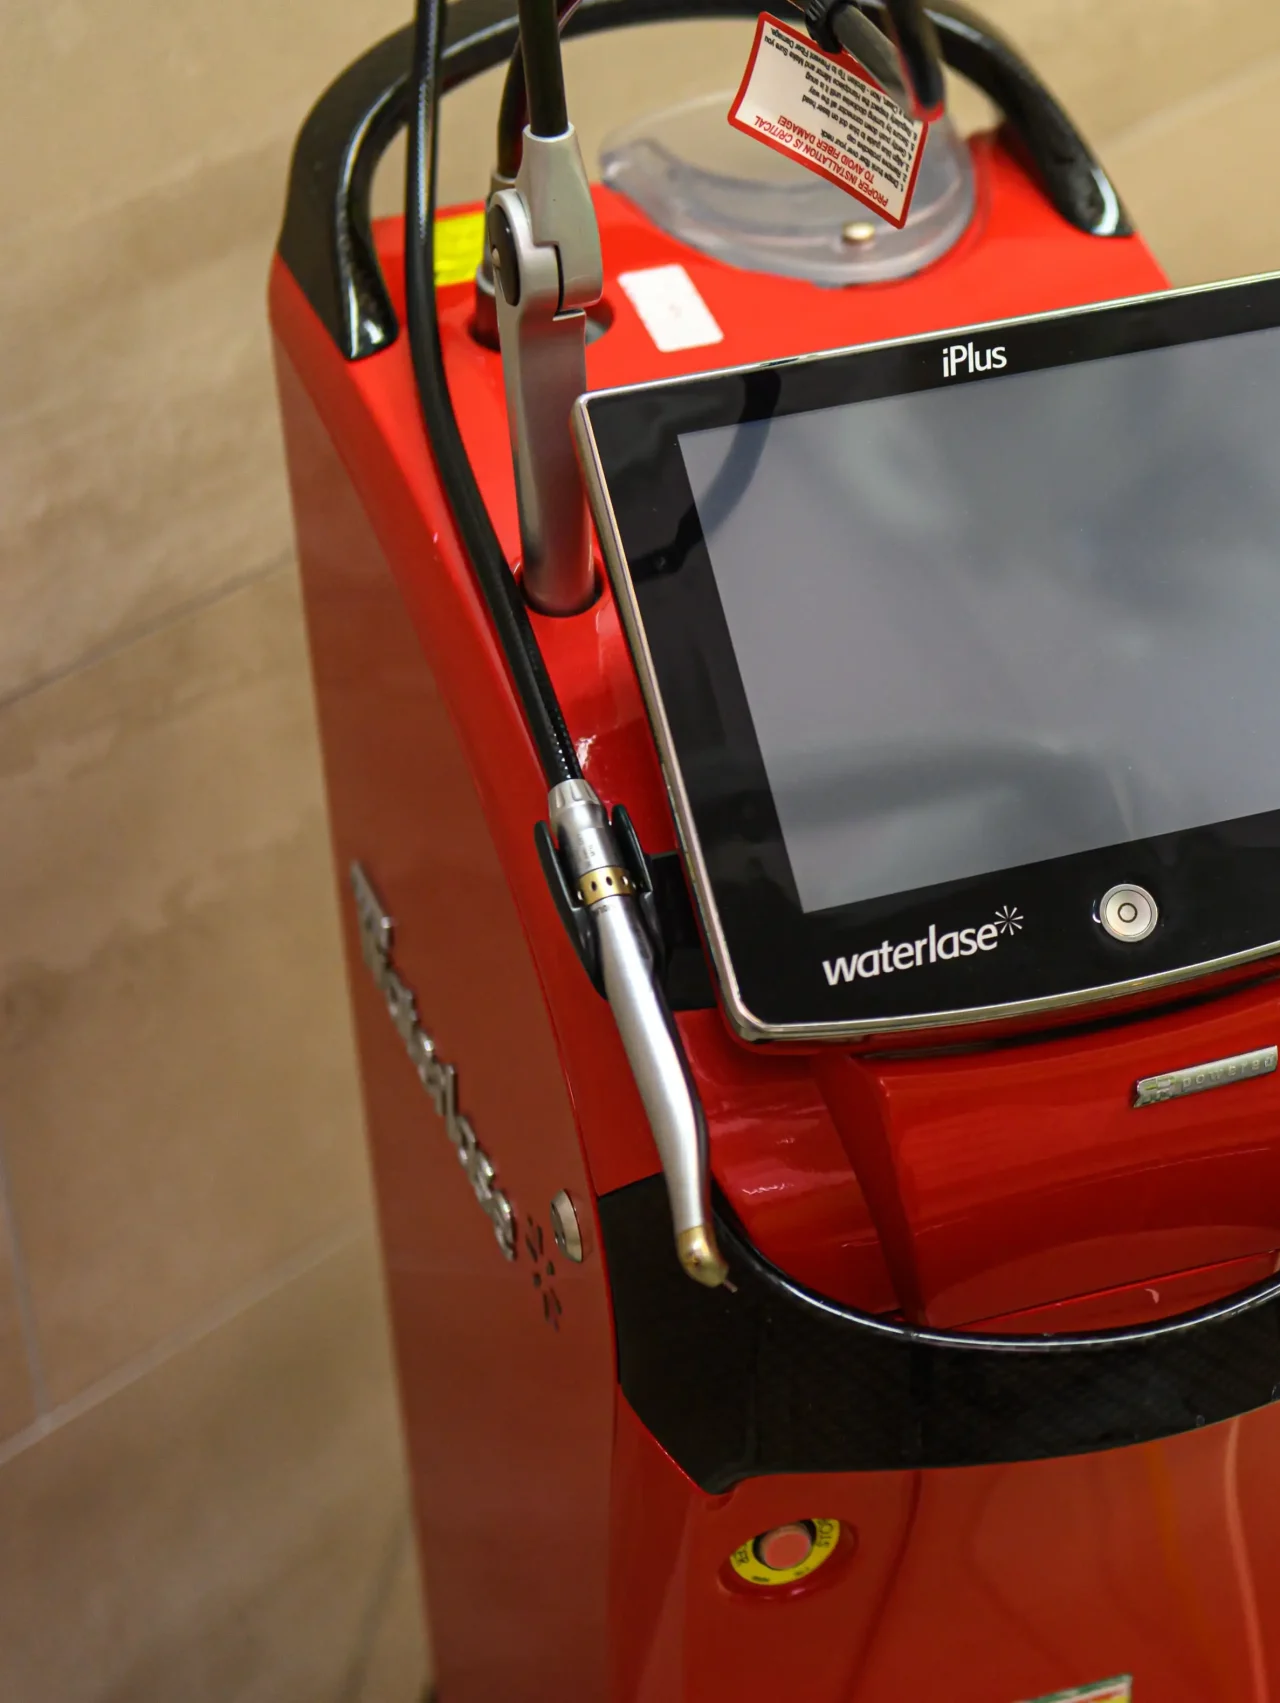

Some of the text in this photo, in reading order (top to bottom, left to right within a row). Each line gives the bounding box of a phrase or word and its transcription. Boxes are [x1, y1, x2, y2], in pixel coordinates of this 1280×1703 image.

[754, 115, 889, 207] PROPER INSTALLATION IS CRITICAL
[777, 115, 874, 184] TO AVOID FIBER DAMAGE!
[942, 341, 1008, 378] iPlus
[822, 924, 998, 986] waterlase
[1182, 1053, 1275, 1093] powered
